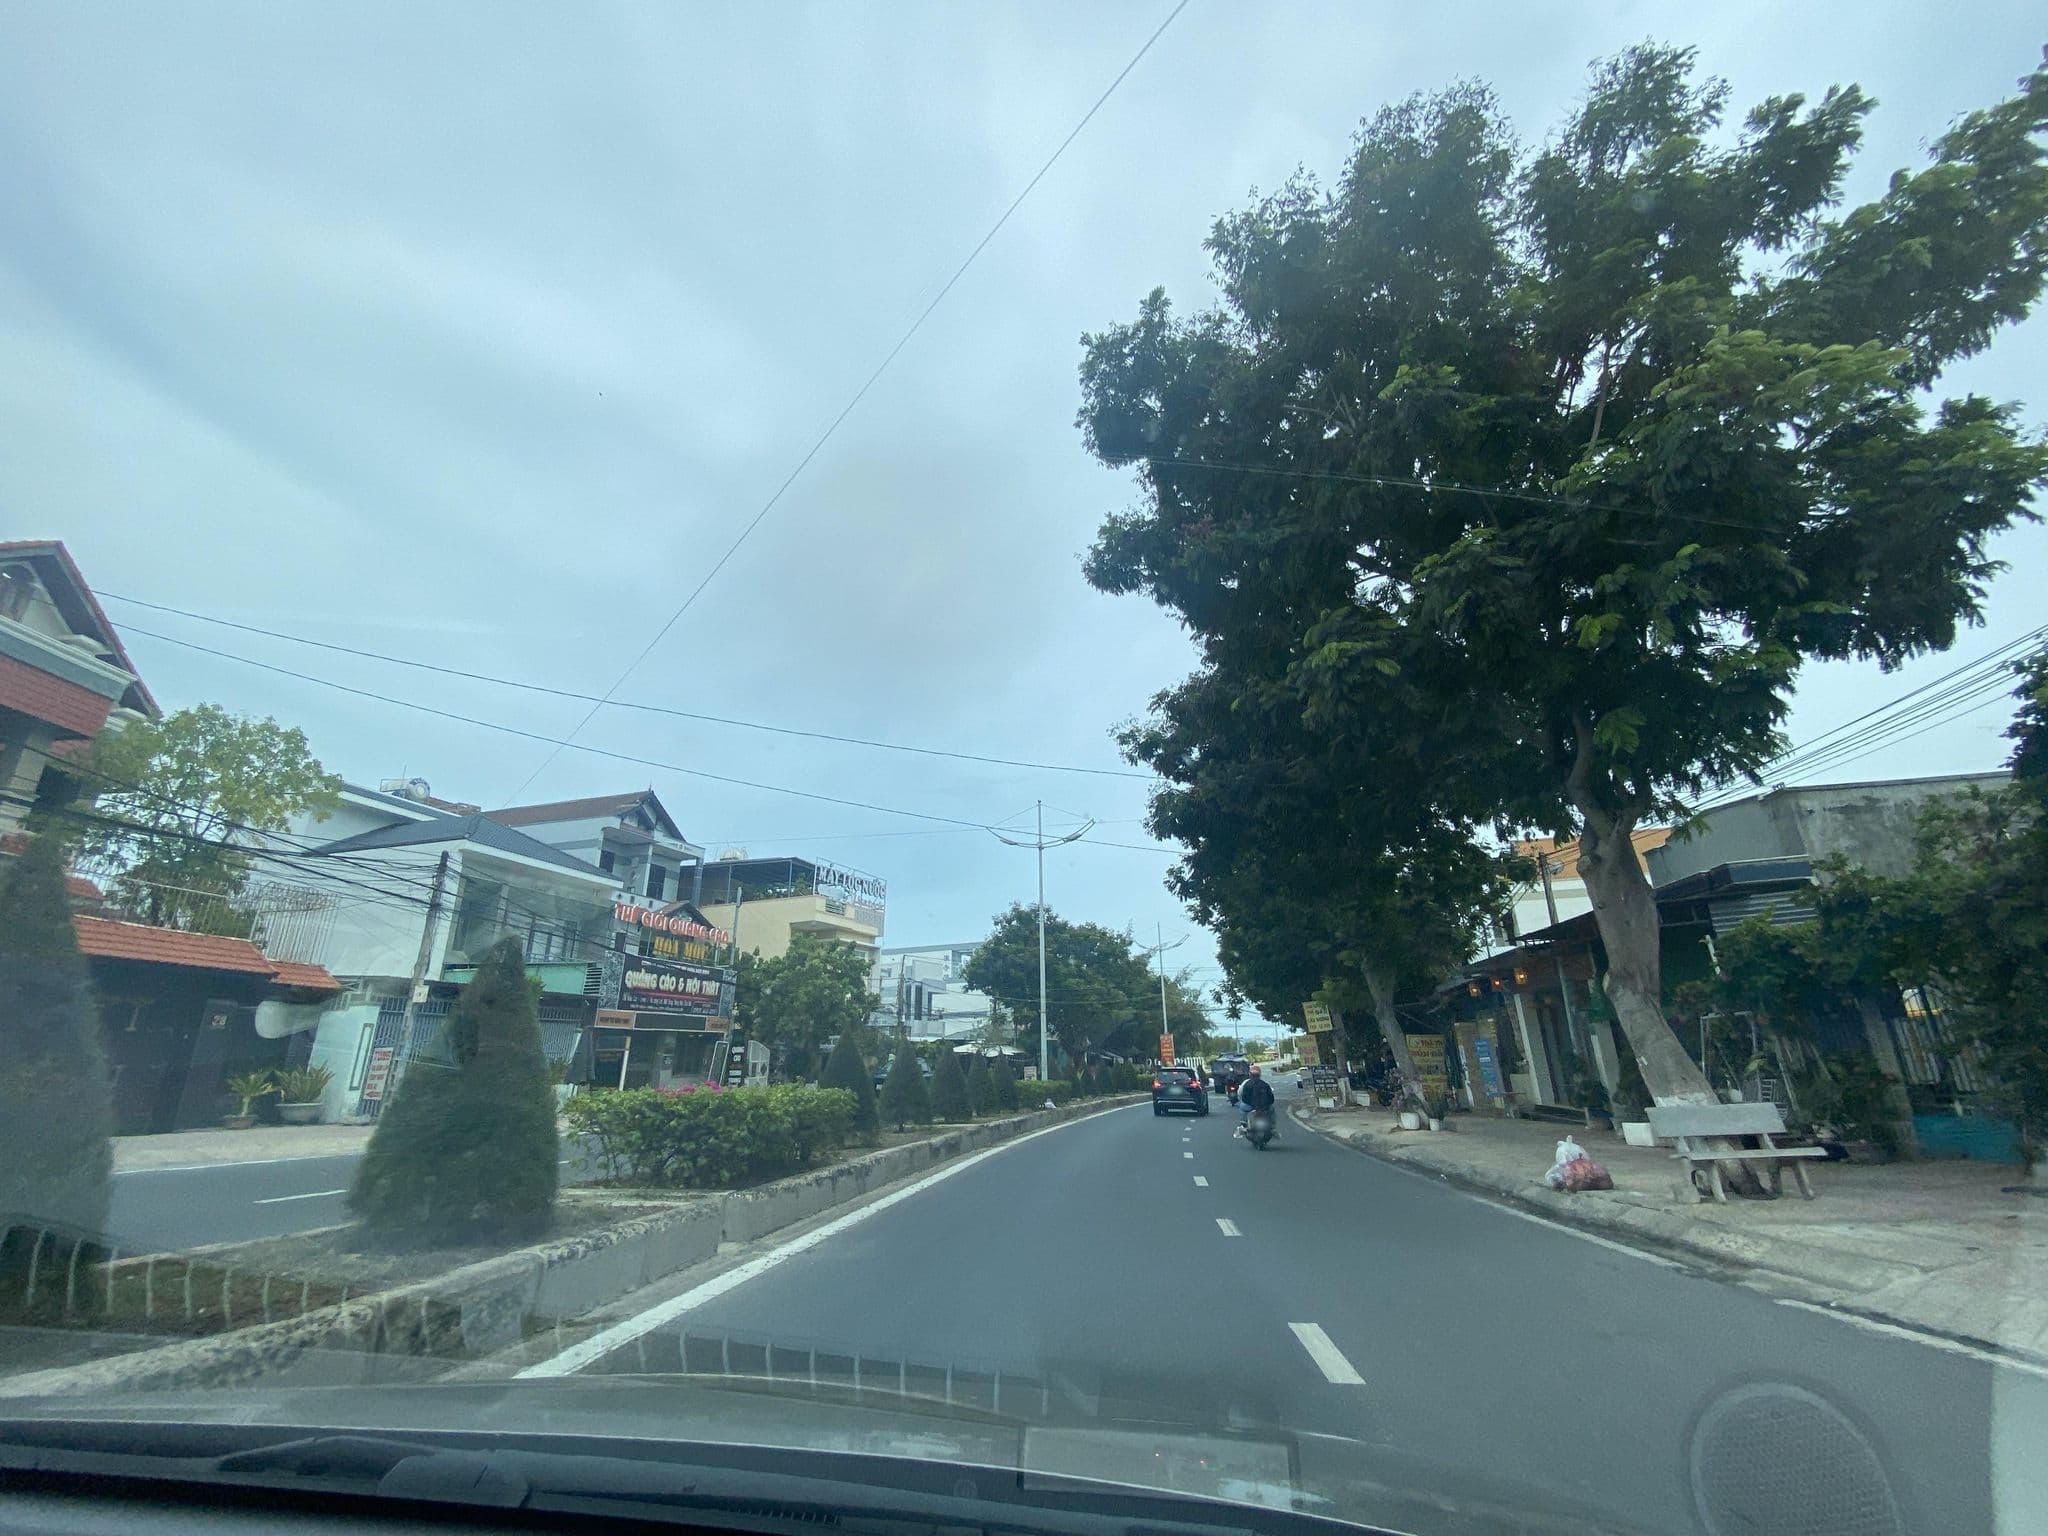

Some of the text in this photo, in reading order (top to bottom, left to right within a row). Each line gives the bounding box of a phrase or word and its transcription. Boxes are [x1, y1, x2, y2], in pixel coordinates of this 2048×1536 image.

[818, 863, 840, 886] MÁY
[614, 903, 639, 924] THẾ
[641, 911, 668, 931] GIỚI
[668, 917, 708, 939] QUẢNG
[625, 968, 658, 989] QUẢNG
[659, 973, 676, 992] CÁO
[678, 977, 685, 992] &
[685, 977, 700, 995] NỘI
